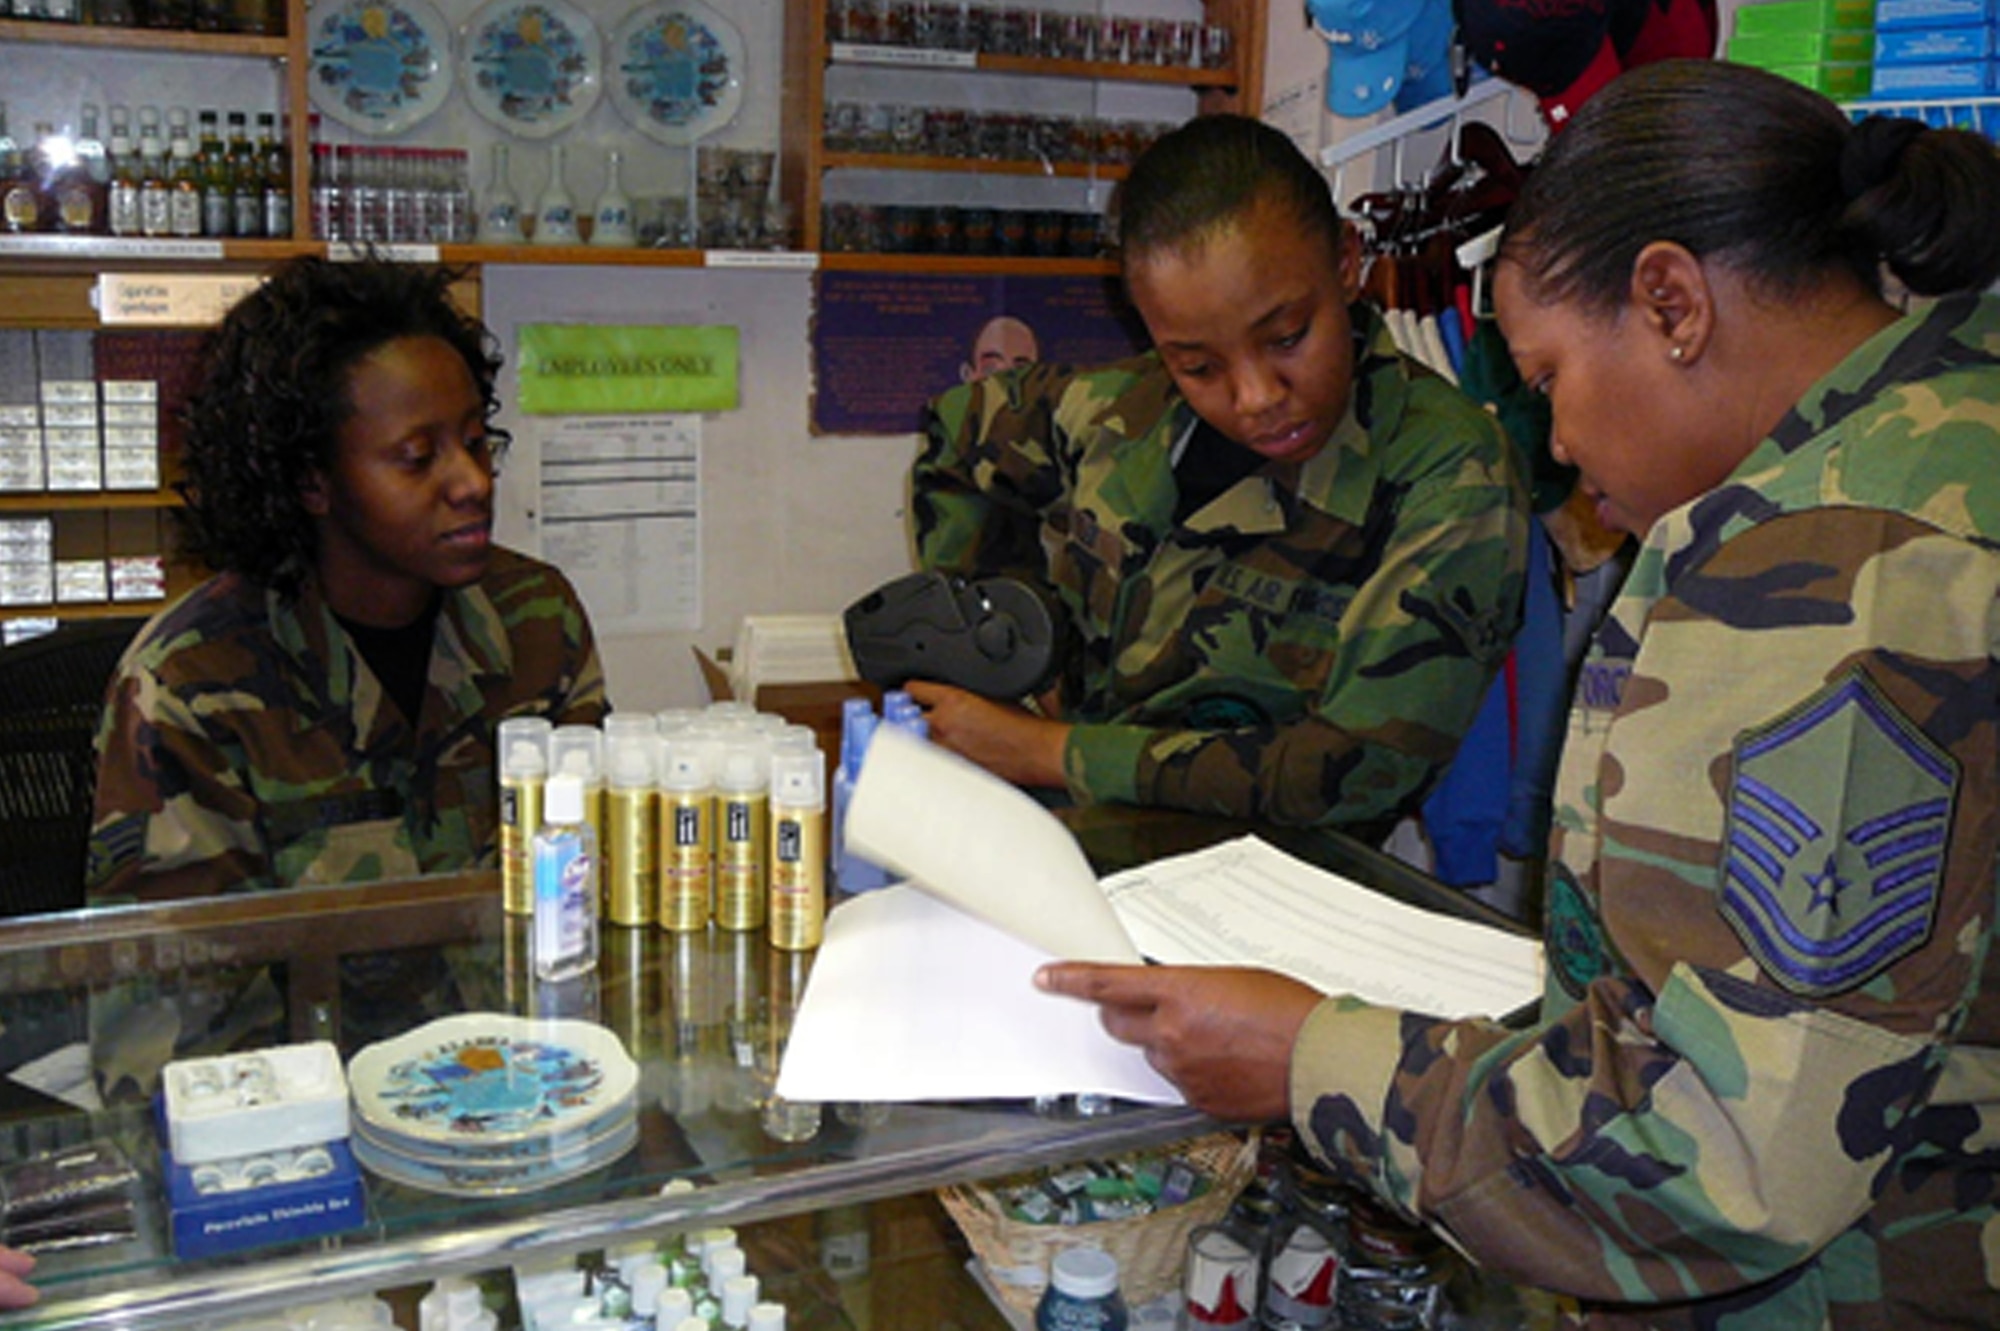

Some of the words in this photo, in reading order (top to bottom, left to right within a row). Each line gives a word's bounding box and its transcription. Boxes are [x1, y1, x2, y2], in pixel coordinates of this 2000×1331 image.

[538, 356, 656, 376] EMPLOYEES
[659, 354, 716, 375] ONLY
[1245, 576, 1283, 604] AIR
[204, 1212, 269, 1235] Porcelain
[271, 1202, 325, 1221] Thimble
